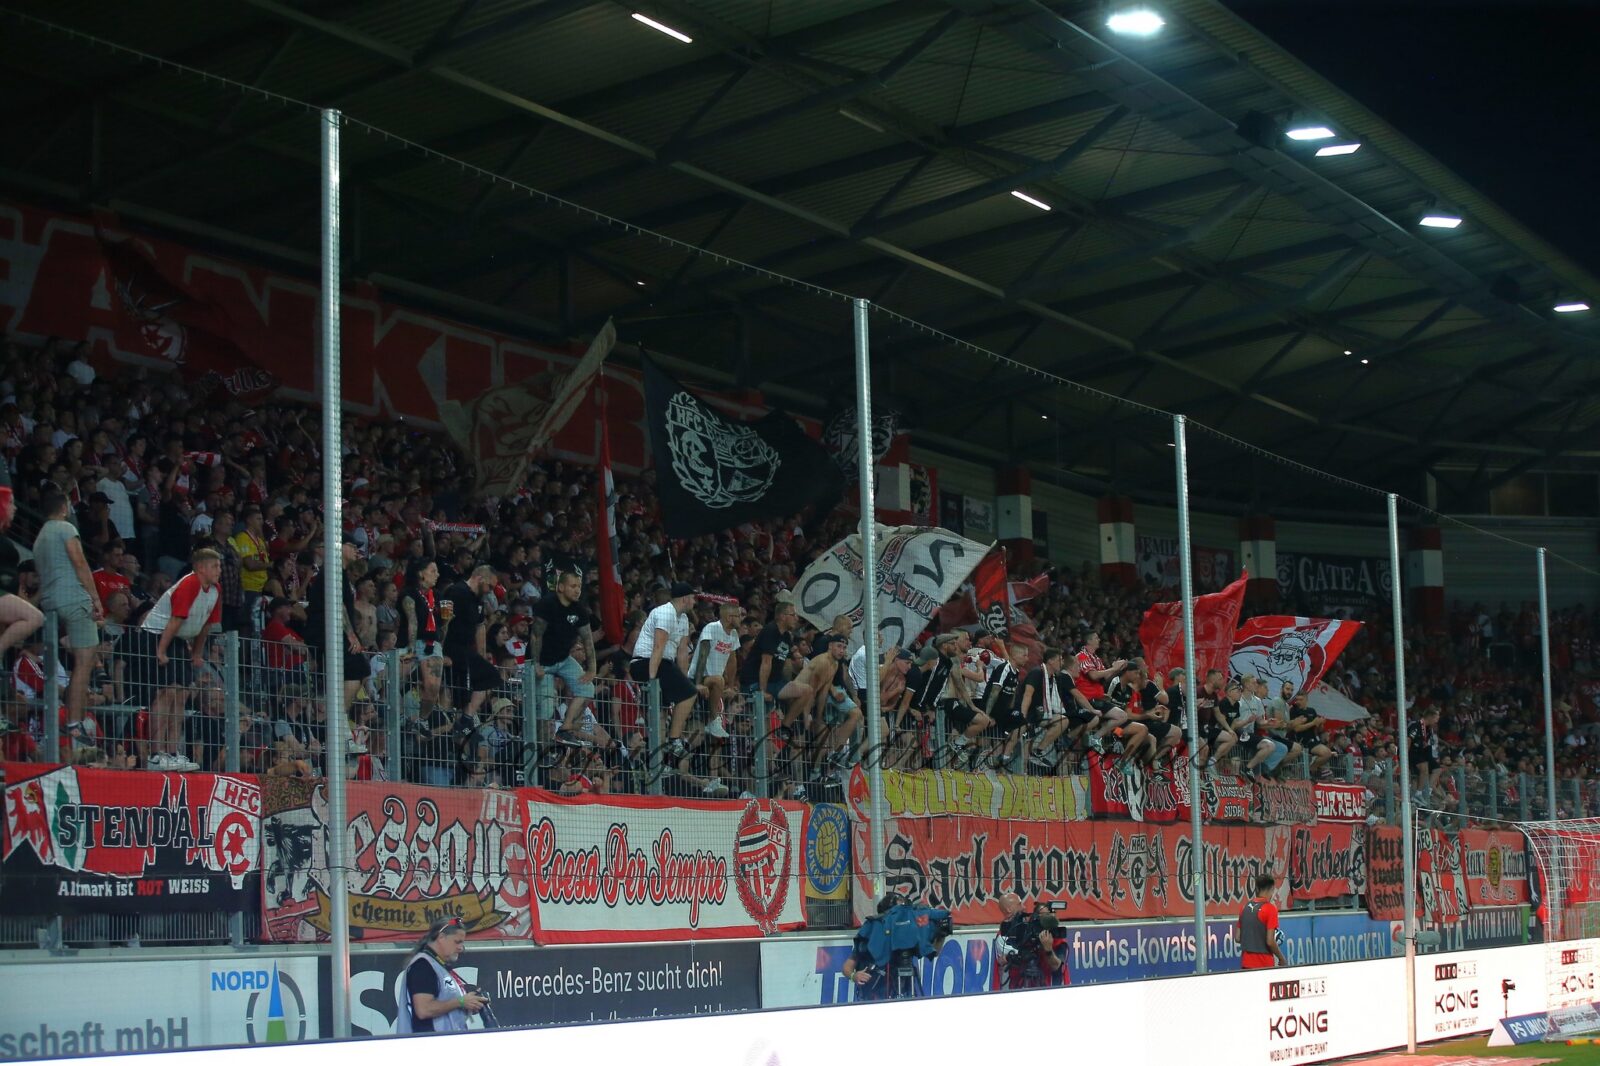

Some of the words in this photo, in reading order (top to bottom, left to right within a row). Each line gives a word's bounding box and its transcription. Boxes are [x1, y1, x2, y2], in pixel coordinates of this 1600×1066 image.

[676, 408, 703, 432] HFC
[224, 782, 260, 813] HFC
[57, 803, 216, 850] STENDAL
[602, 822, 648, 908] Per
[649, 827, 728, 929] Sempre
[884, 833, 1103, 911] Saalefront
[1292, 829, 1351, 890] Köthen
[58, 880, 113, 897] Altmark
[116, 881, 134, 897] ist
[137, 880, 164, 896] ROT
[168, 879, 210, 894] WEISS
[352, 901, 416, 928] chemie
[1467, 910, 1522, 940] AUTOMATION
[1072, 925, 1242, 969] fuchs-kovatsh.de
[1286, 936, 1327, 965] RADIO
[1330, 931, 1386, 962] BROCKEN
[211, 970, 270, 991] NORD
[497, 965, 632, 999] Mercedes-Benz
[637, 963, 681, 991] sucht
[686, 961, 723, 987] dich!
[1435, 986, 1479, 1014] KÖNIG
[116, 1016, 189, 1052] mbH
[1270, 1006, 1328, 1040] KÖNIG
[1509, 1022, 1527, 1038] PS
